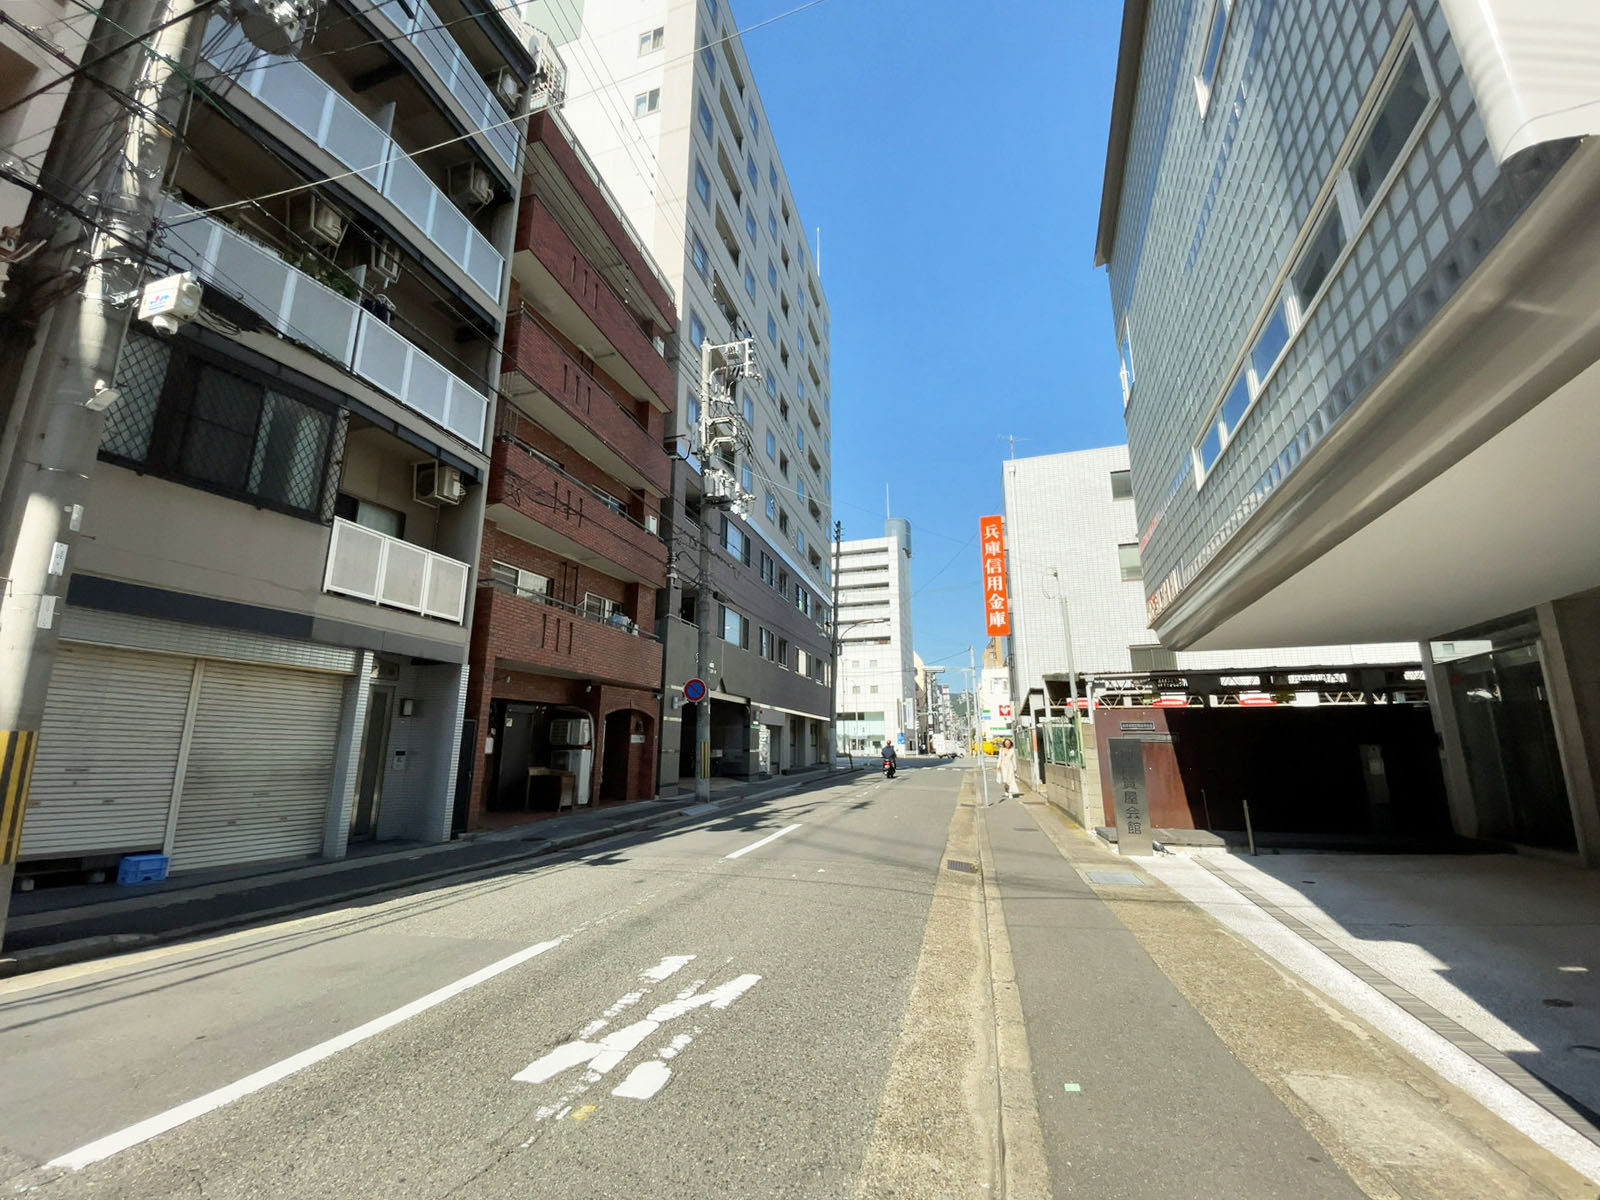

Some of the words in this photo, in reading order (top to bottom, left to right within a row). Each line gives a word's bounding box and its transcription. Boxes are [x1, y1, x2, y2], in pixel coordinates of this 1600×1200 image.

[984, 524, 1006, 627] 兵庫信用金庫
